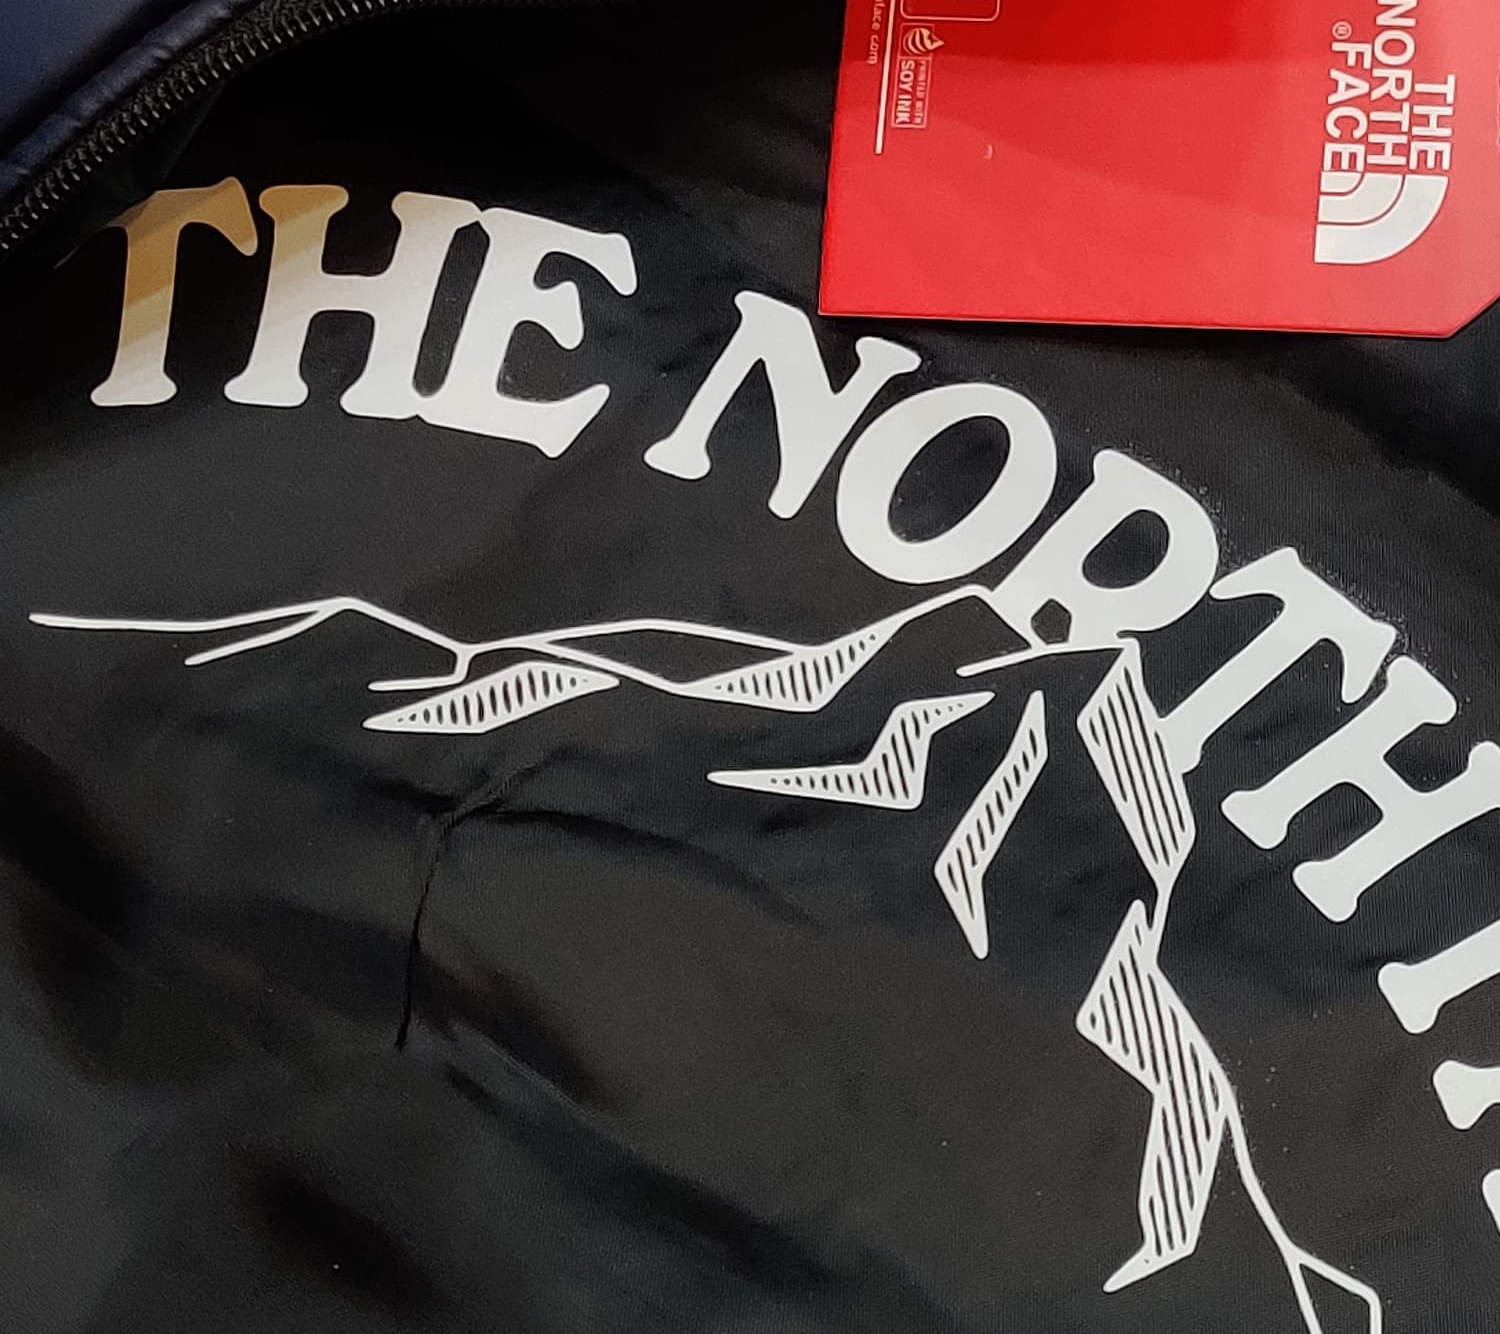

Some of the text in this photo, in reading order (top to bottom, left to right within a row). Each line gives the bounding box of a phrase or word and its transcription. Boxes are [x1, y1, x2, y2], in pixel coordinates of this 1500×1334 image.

[896, 59, 916, 124] SOY INK
[1408, 74, 1456, 171] THE
[90, 176, 638, 458] THE
